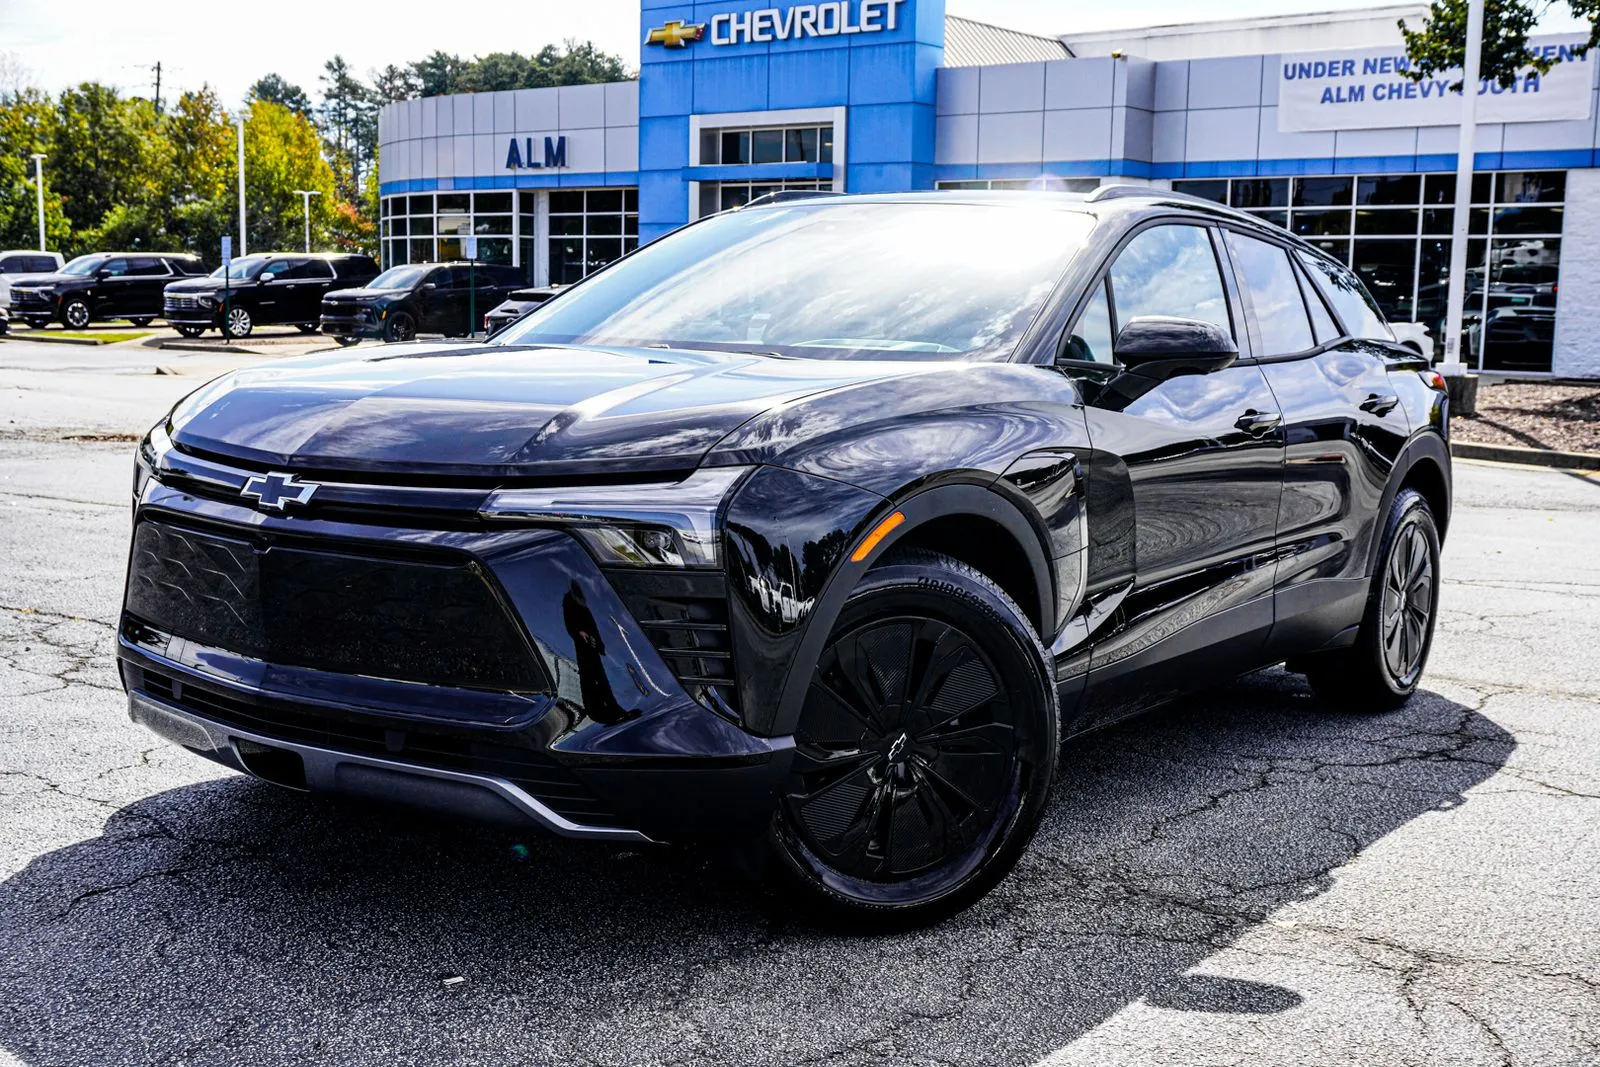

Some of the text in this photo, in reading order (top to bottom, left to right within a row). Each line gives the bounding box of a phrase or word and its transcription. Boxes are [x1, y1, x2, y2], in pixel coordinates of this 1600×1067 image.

[711, 0, 904, 46] CHEVROLET
[1284, 56, 1412, 80] UNDER NEW
[1320, 75, 1540, 104] ALM CHEVY UTH
[506, 136, 567, 168] ALM
